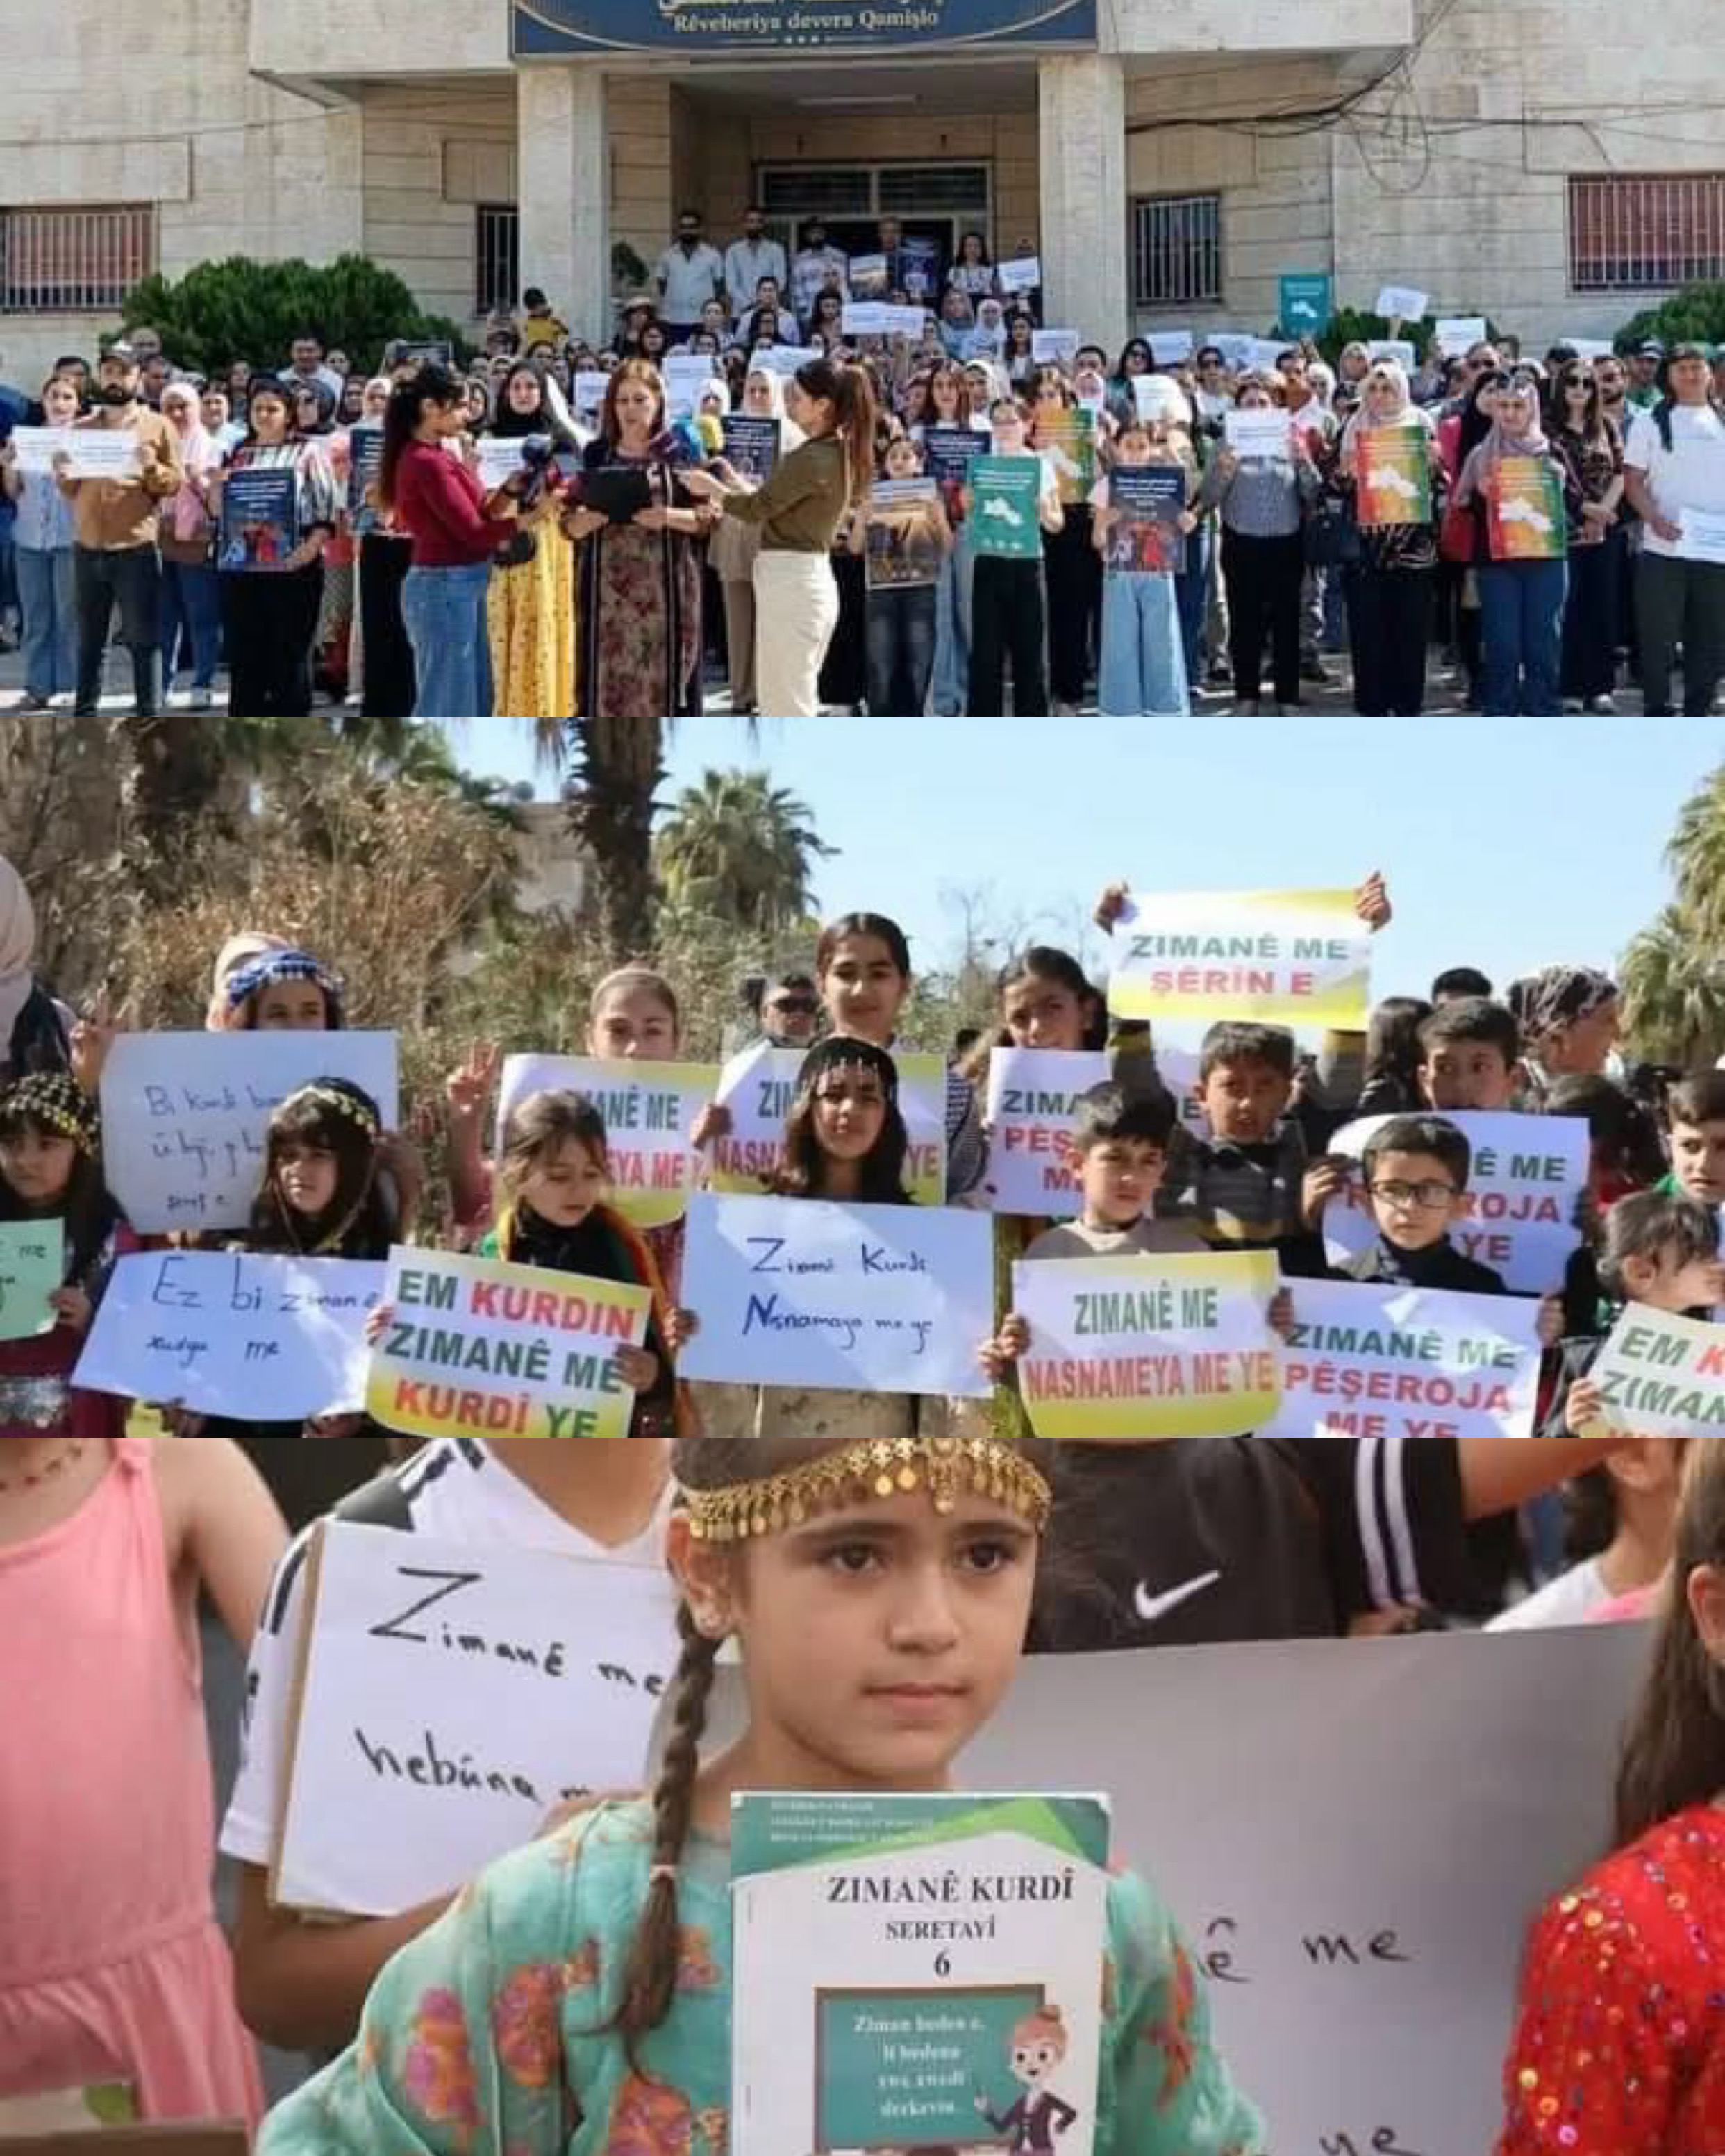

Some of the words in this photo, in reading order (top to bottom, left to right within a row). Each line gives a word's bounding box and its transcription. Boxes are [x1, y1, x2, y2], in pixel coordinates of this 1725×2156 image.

[1130, 931, 1279, 958] ZIMANÊ
[1293, 938, 1351, 960] ME
[1290, 972, 1312, 995] E
[646, 1093, 678, 1130] ME
[1003, 1090, 1081, 1115] ZIMA
[651, 1150, 684, 1189] ME
[906, 1144, 939, 1177] YE
[1510, 1154, 1566, 1182] ME
[1465, 1191, 1560, 1224] ROJA
[1462, 1231, 1512, 1260] YE
[153, 1256, 203, 1308] Ez
[230, 1256, 262, 1311] bi
[397, 1270, 459, 1310] EM
[469, 1281, 635, 1340] KURDIN
[1073, 1279, 1174, 1335] ZIMANÊ
[1181, 1287, 1217, 1329] ME
[385, 1322, 551, 1382] ZIMANÊ
[563, 1350, 625, 1394] ME
[1285, 1323, 1442, 1361] ZIMANÊ
[1458, 1338, 1515, 1370] ME
[1620, 1326, 1690, 1366] EM
[1026, 1354, 1185, 1400] NASNAMEYA
[1192, 1351, 1231, 1395] ME
[1238, 1350, 1275, 1392] YE
[1285, 1361, 1511, 1413] PÊŞEROJA
[394, 1379, 531, 1434] KURDÎ
[544, 1404, 599, 1438] YE
[1602, 1370, 1725, 1423] ZIMAN
[1326, 1411, 1385, 1438] ME
[368, 1566, 565, 1677] Zimanê
[597, 1662, 665, 1695] me
[828, 1868, 960, 1904] ZIMANÊ
[972, 1866, 1075, 1902] KURDÎ
[934, 1948, 951, 1977] 6
[1197, 1917, 1252, 1984] ê
[1301, 1930, 1412, 1964] me
